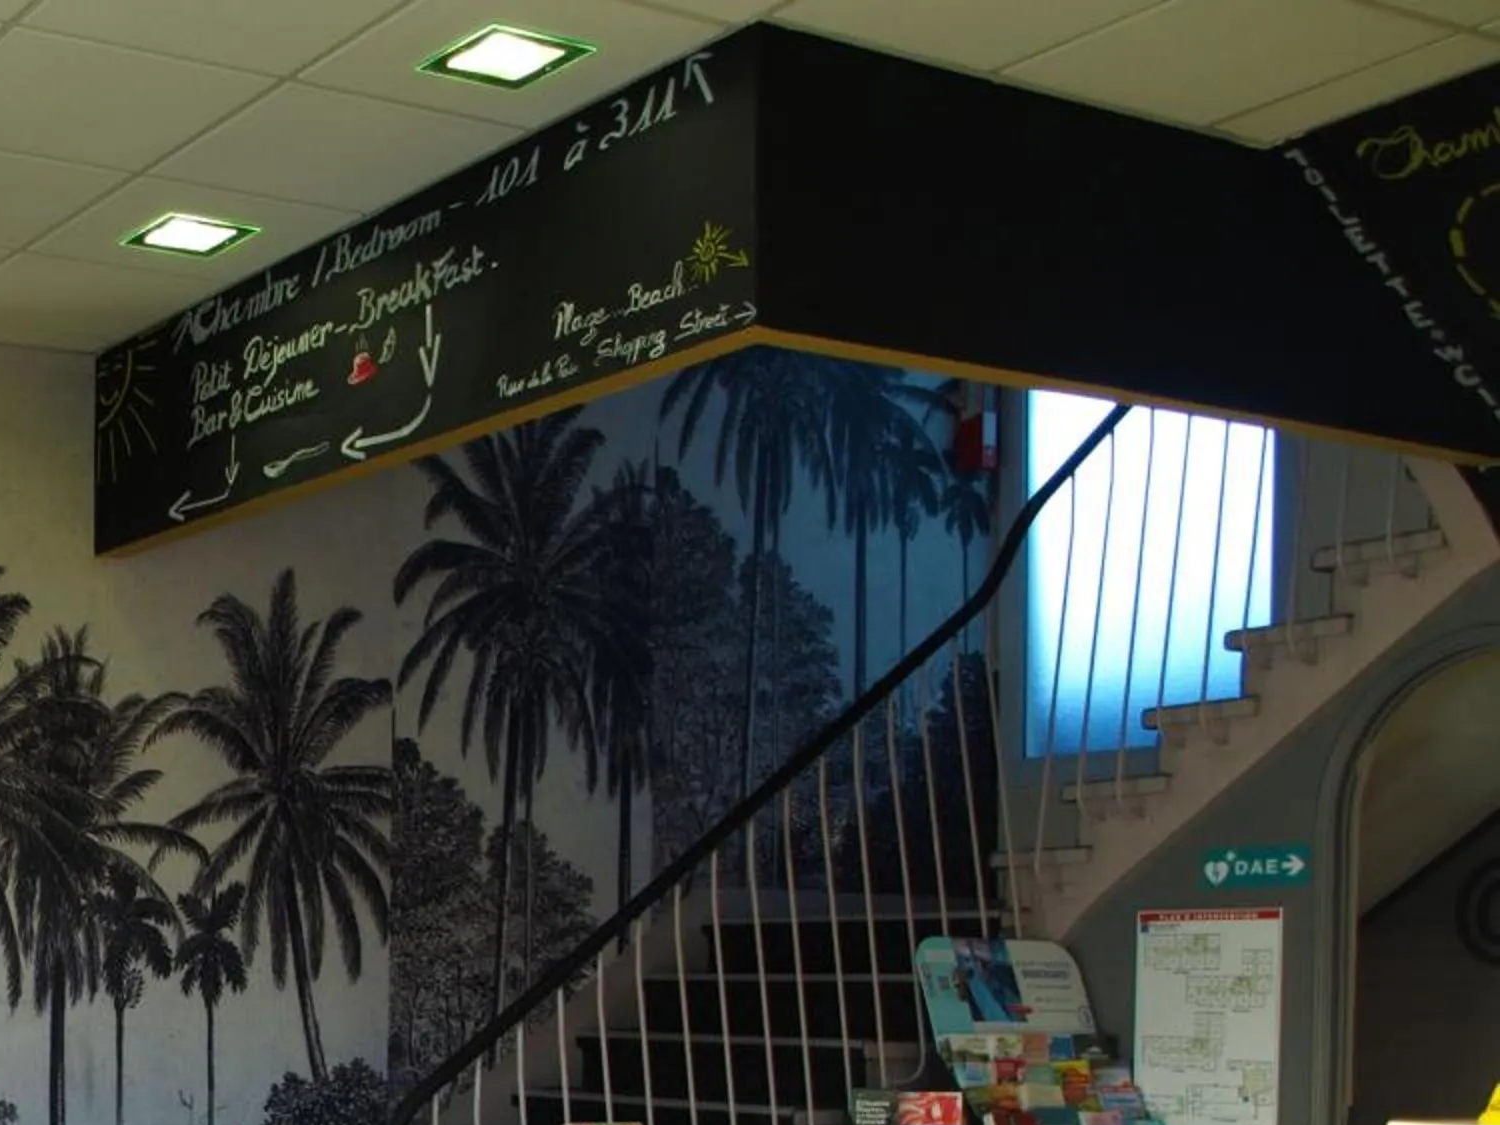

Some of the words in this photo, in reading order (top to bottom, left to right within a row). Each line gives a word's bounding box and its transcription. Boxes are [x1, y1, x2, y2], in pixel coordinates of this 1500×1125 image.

[326, 210, 443, 283] Bedroom
[475, 145, 541, 207] 101
[599, 76, 678, 150] 311
[187, 405, 229, 450] Bar
[244, 374, 321, 422] Cuisine
[1233, 858, 1279, 877] DAE
